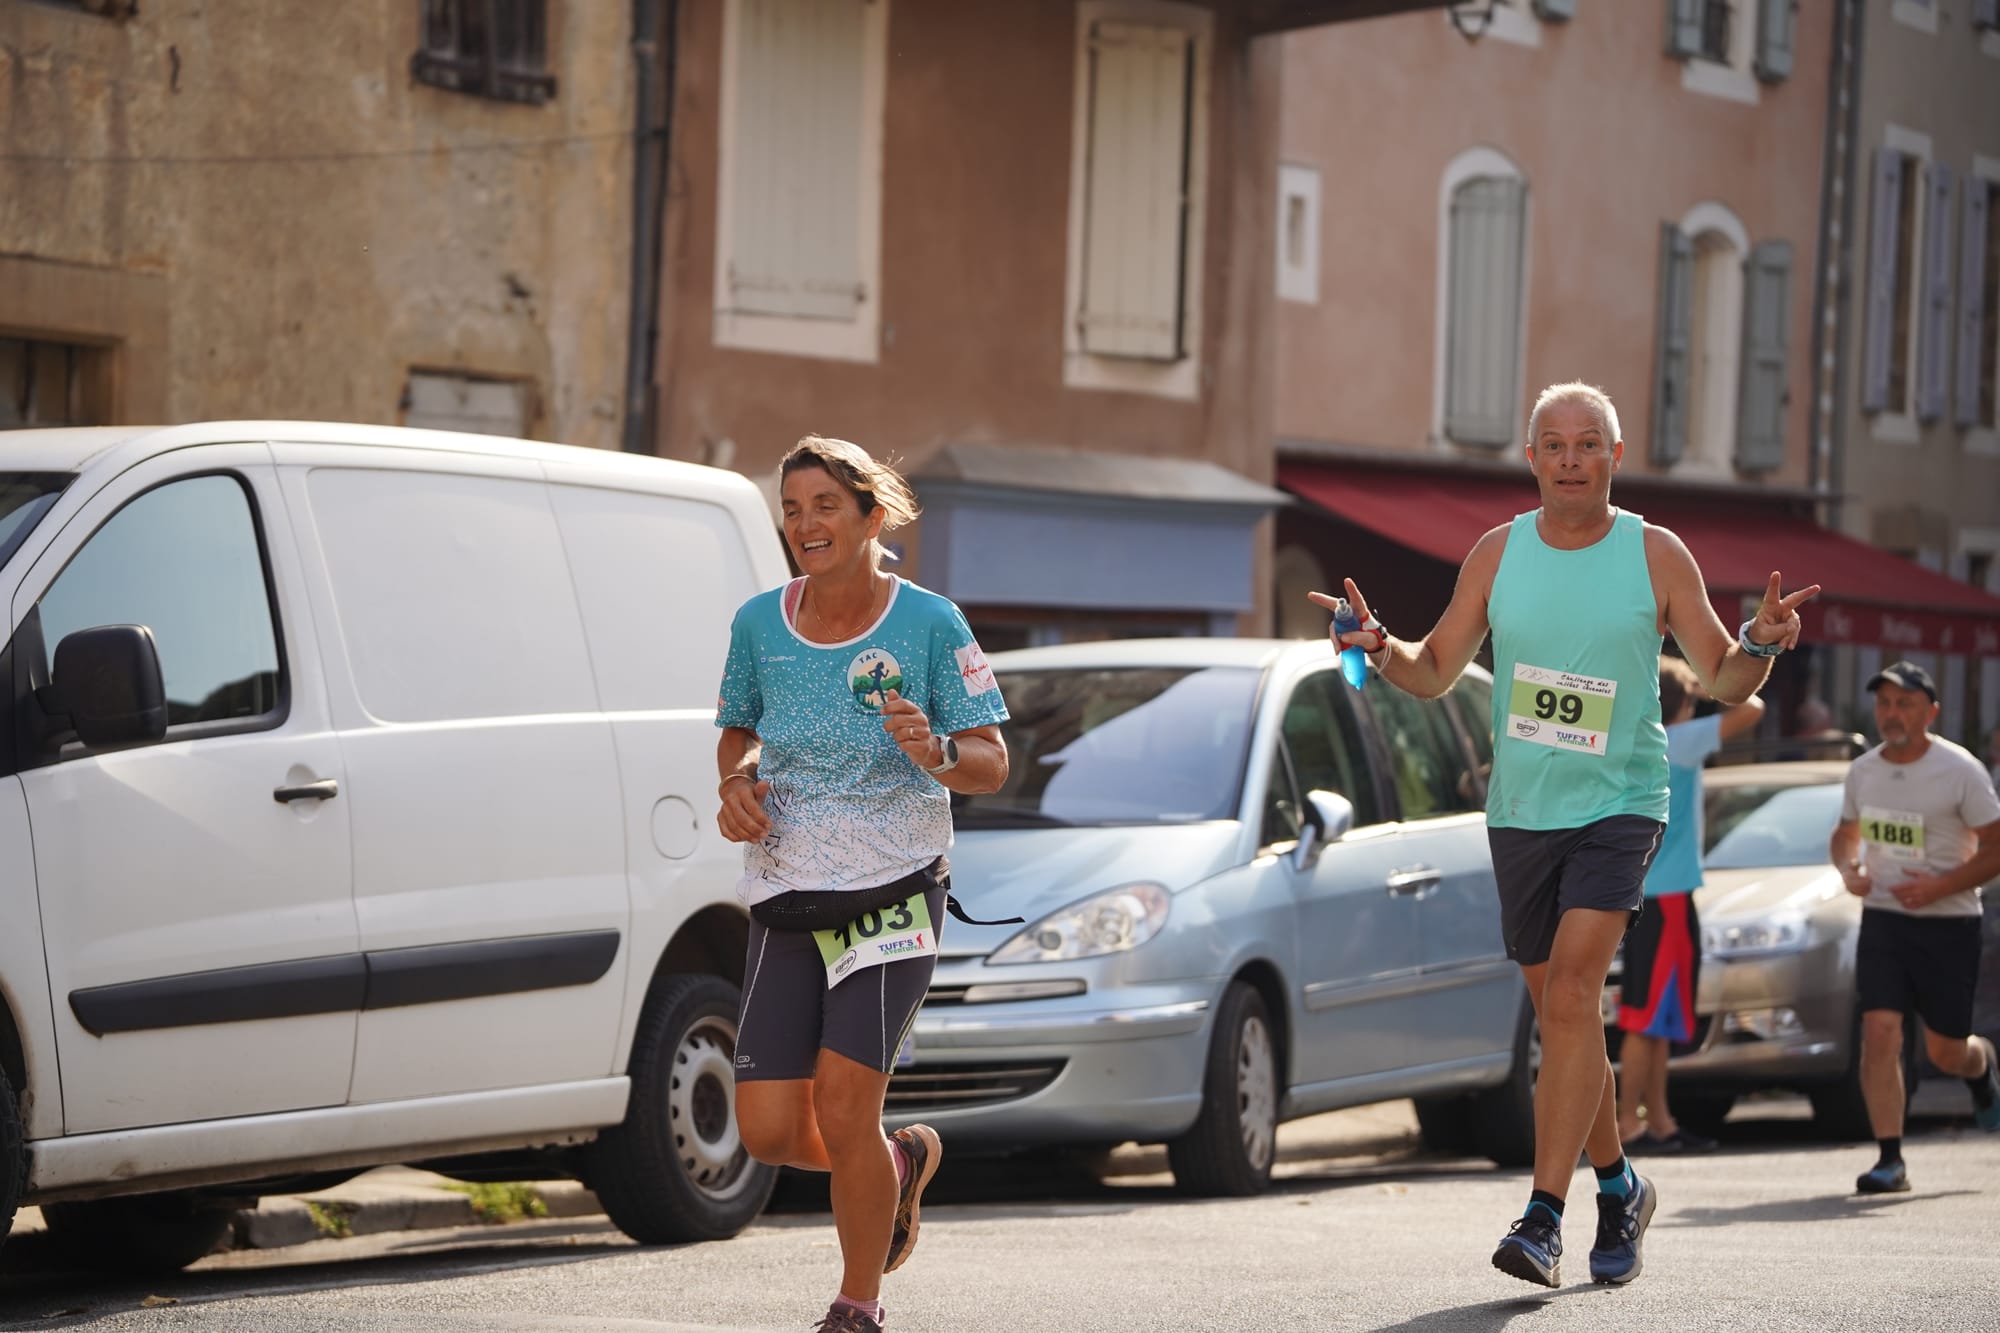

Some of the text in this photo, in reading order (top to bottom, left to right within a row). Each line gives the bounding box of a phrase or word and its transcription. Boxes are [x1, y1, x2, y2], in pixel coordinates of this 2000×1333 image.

[858, 652, 878, 664] TAC
[1534, 689, 1583, 724] 99
[1556, 731, 1587, 742] TUFF'S
[1869, 821, 1913, 845] 188
[834, 900, 913, 950] 103
[879, 939, 914, 952] TUFF'S
